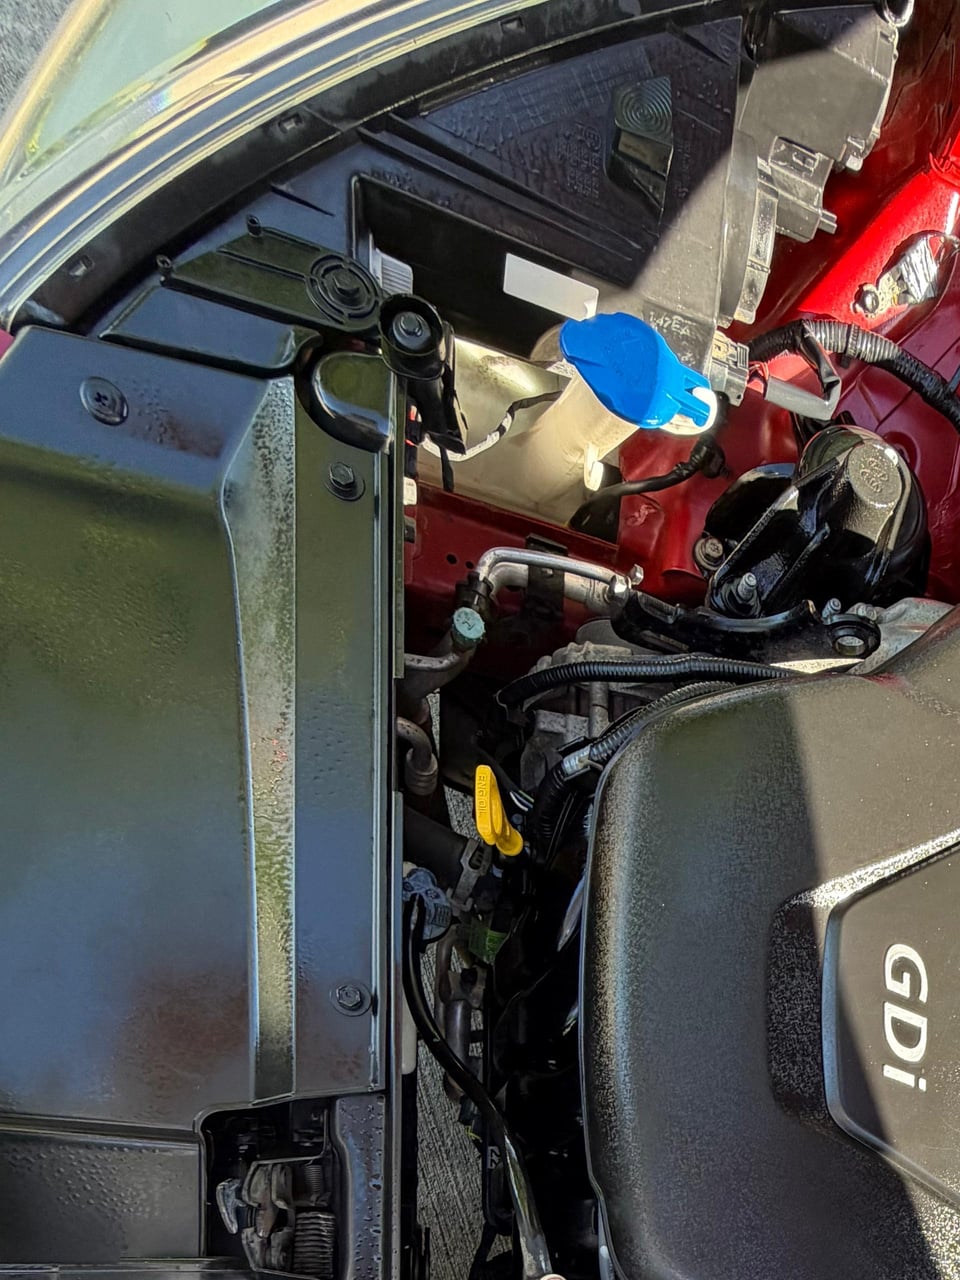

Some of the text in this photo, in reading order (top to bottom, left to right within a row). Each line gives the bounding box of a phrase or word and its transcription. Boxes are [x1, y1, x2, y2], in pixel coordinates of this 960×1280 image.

[478, 774, 488, 817] ENG OIL
[883, 943, 928, 1092] GDi
[490, 1148, 502, 1168] 22
